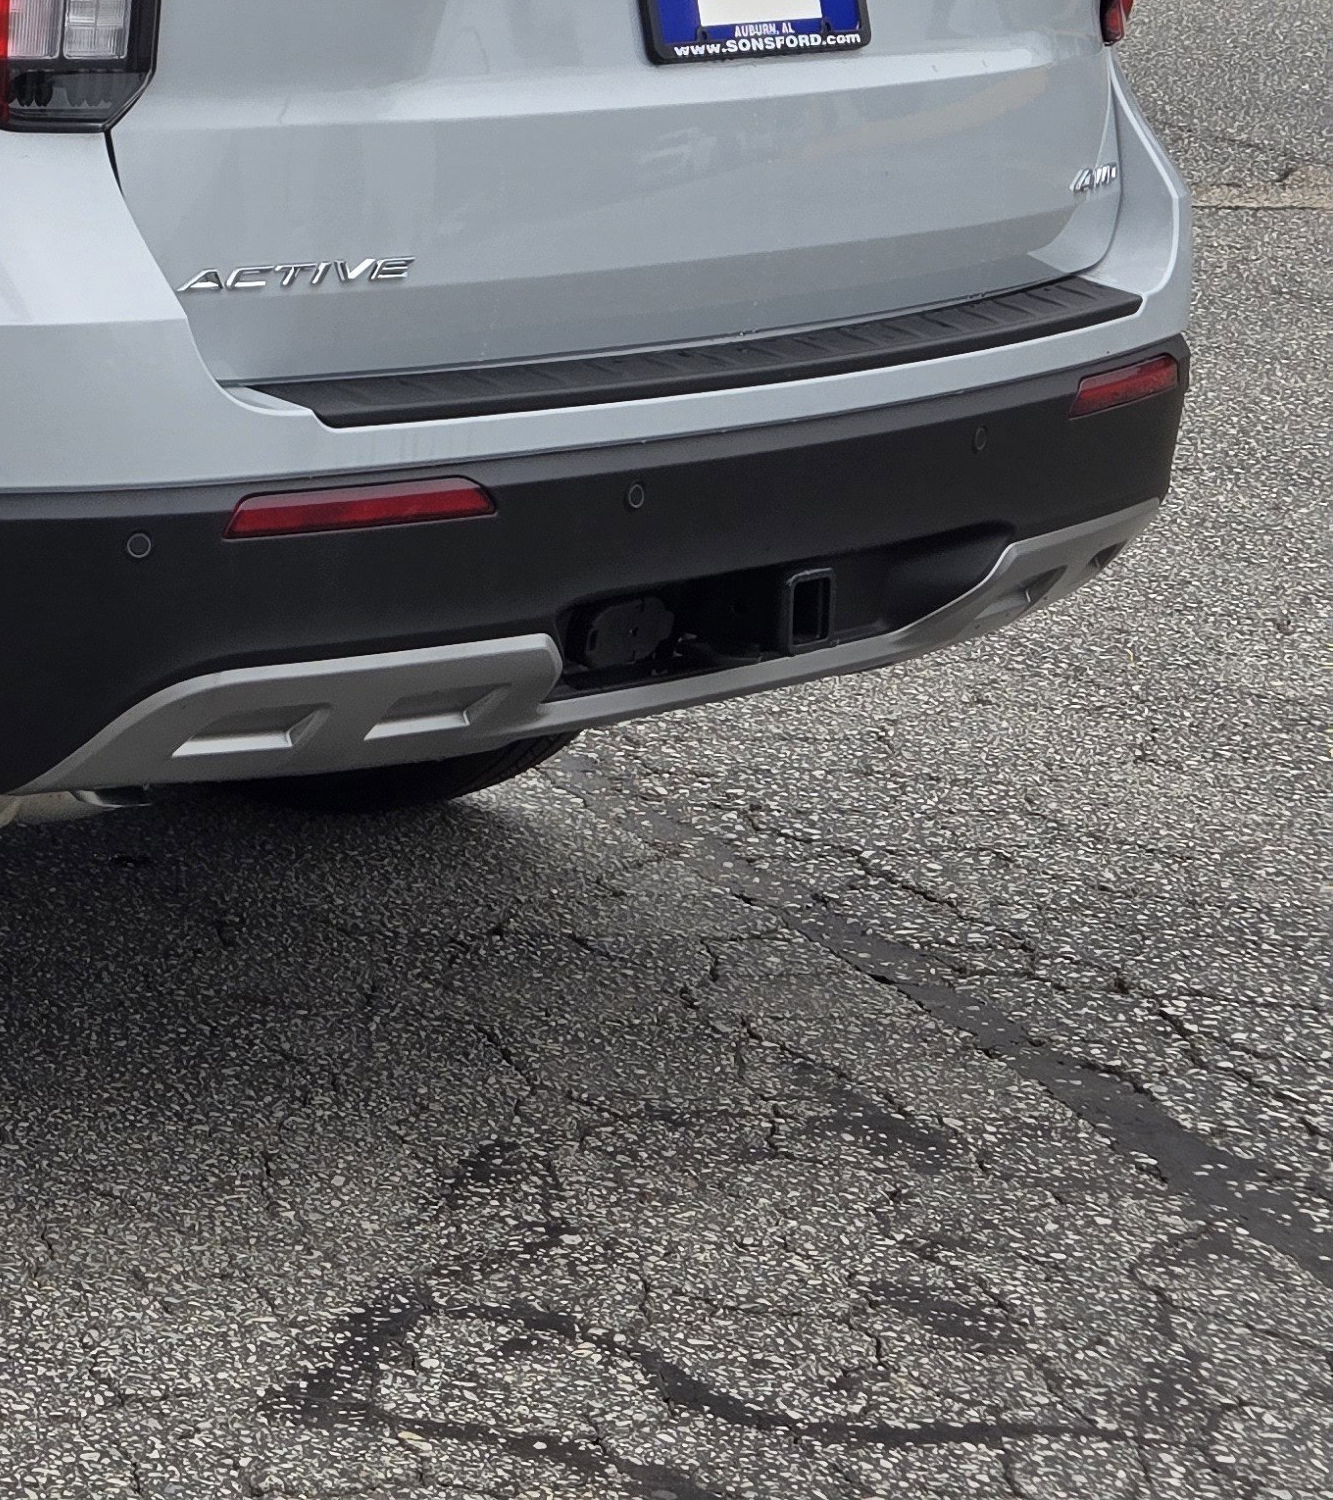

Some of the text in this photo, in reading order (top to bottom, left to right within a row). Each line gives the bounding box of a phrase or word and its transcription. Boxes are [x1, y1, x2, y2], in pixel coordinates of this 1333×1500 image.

[782, 22, 795, 34] AL
[674, 33, 861, 57] www.SONSFORD.com
[176, 256, 416, 292] ACTIVE
